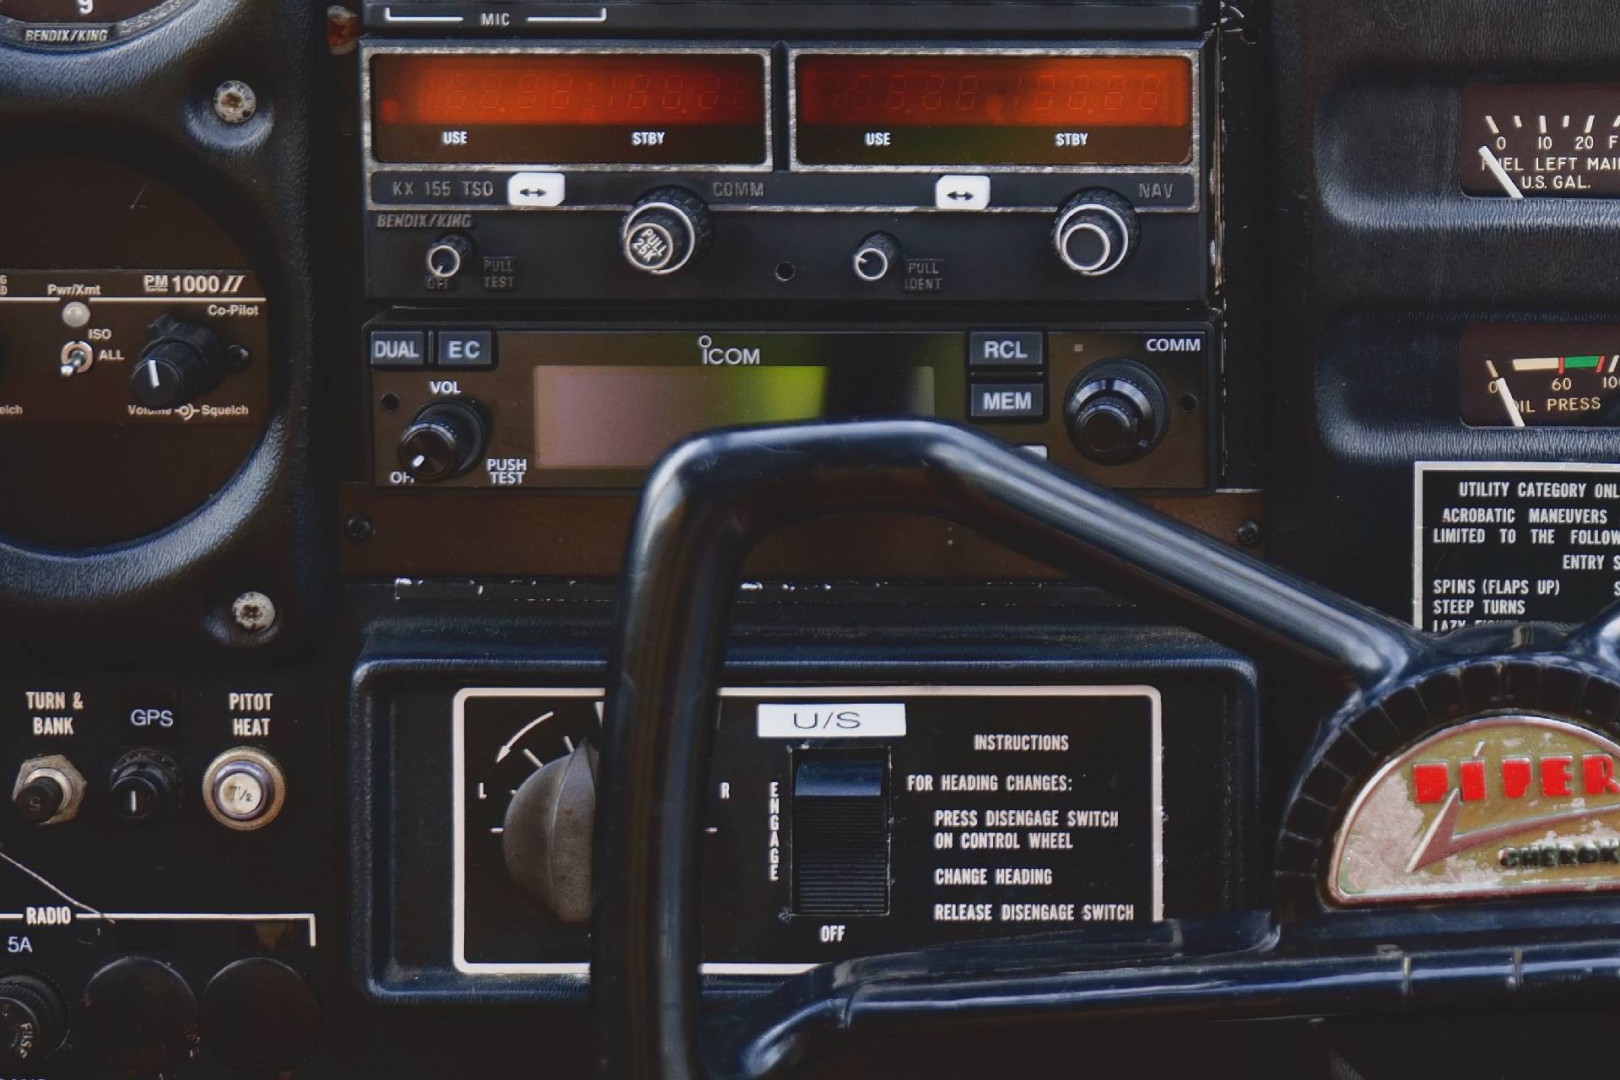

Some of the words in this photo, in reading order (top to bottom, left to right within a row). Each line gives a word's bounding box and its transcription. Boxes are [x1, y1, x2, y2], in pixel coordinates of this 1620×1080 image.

[25, 29, 109, 42] BENDIX/KING
[442, 131, 468, 145] USE
[631, 131, 666, 146] STBY
[1535, 157, 1578, 171] LEFT
[47, 284, 101, 297] Pwr/Xmt
[172, 275, 220, 293] 1000
[207, 305, 259, 317] Co-Pilot
[374, 340, 419, 358] DUAL
[449, 341, 481, 359] EC
[984, 341, 1028, 359] RCL
[1146, 338, 1201, 352] COMM
[430, 381, 462, 395] VOL
[983, 393, 1032, 410] MEM
[1547, 398, 1601, 412] PRESS
[201, 405, 249, 417] Squelch
[487, 458, 527, 472] PUSH
[489, 471, 525, 485] TEST
[1459, 482, 1509, 497] UTILITY
[1517, 482, 1586, 498] CATEGORY
[1442, 507, 1516, 523] ACROBATIC
[1529, 508, 1608, 524] MANEUVERS
[1433, 528, 1486, 544] LIMITED
[1500, 529, 1517, 544] TO
[1530, 529, 1556, 544] THE
[1563, 554, 1605, 570] ENTRY
[1433, 579, 1476, 595] SPINS
[1482, 579, 1529, 596] (FLAPS
[1537, 579, 1560, 595] UP)
[1433, 599, 1474, 615] STEEP
[1482, 600, 1526, 615] TURNS
[26, 691, 68, 711] TURN
[228, 692, 273, 711] PITOT
[33, 717, 74, 736] BANK
[130, 709, 174, 728] GPS
[792, 712, 861, 729] U/S
[232, 718, 271, 737] HEAT
[974, 735, 1069, 751] INSTRUCTIONS
[907, 775, 934, 792] FOR
[941, 775, 999, 792] HEADING
[1006, 775, 1073, 792] CHANGES:
[934, 810, 978, 827] PRESS
[985, 810, 1059, 827] DISENGAGE
[1067, 810, 1119, 827] SWITCH
[934, 832, 953, 849] ON
[961, 832, 1020, 849] CONTROL
[1028, 832, 1074, 849] WHEEL
[934, 869, 987, 886] CHANGE
[995, 869, 1053, 886] HEADING
[26, 907, 72, 925] RADIO
[934, 904, 993, 921] RELEASE
[1001, 904, 1075, 921] DISENGAGE
[1082, 904, 1134, 921] SWITCH
[820, 926, 845, 943] OFF
